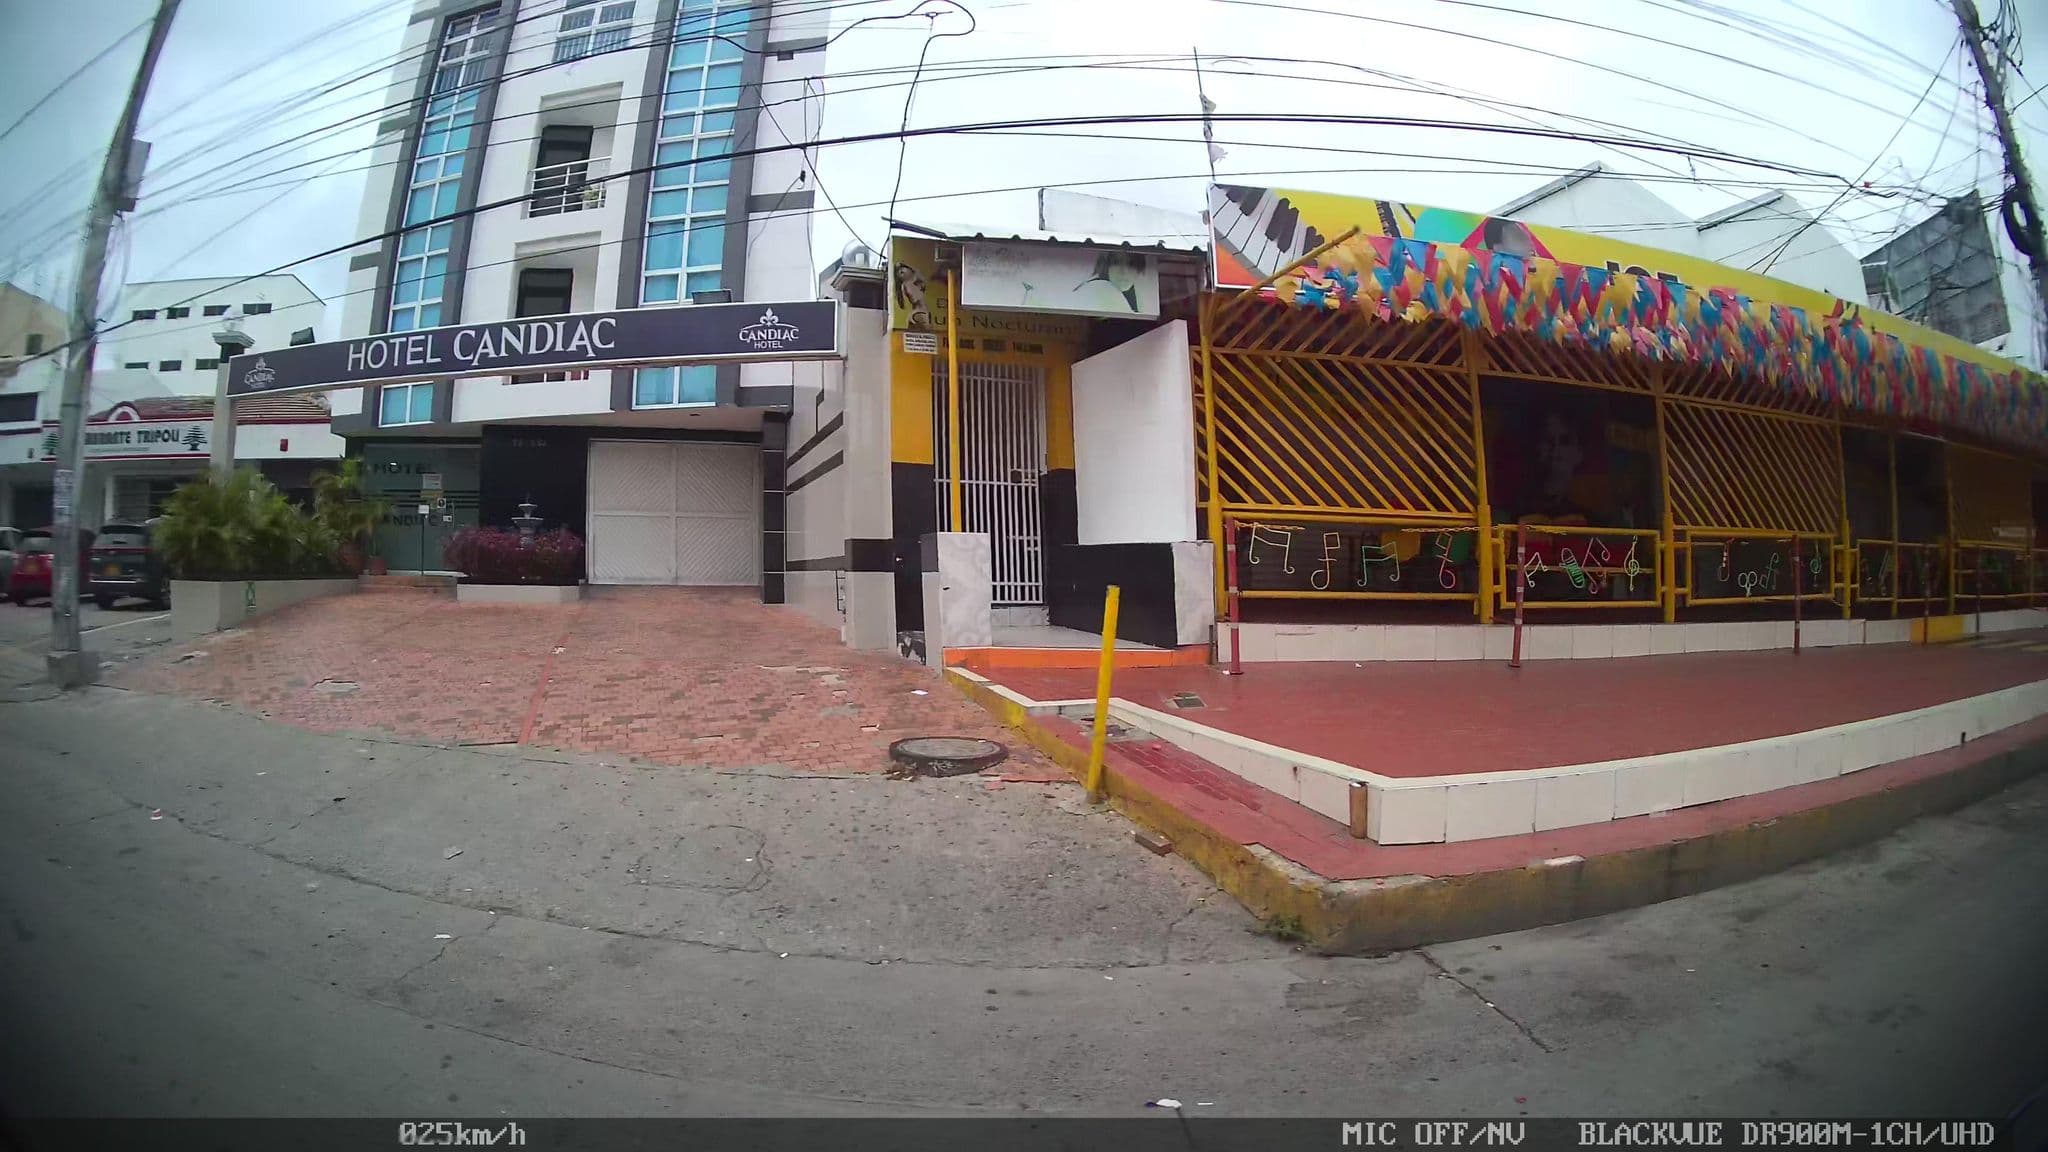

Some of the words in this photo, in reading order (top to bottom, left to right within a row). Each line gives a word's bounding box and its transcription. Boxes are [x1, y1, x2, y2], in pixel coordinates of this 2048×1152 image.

[739, 328, 799, 343] CANDIAC
[347, 335, 442, 372] HOTEL
[453, 318, 617, 366] CANDIAC
[754, 340, 783, 349] HOTEL
